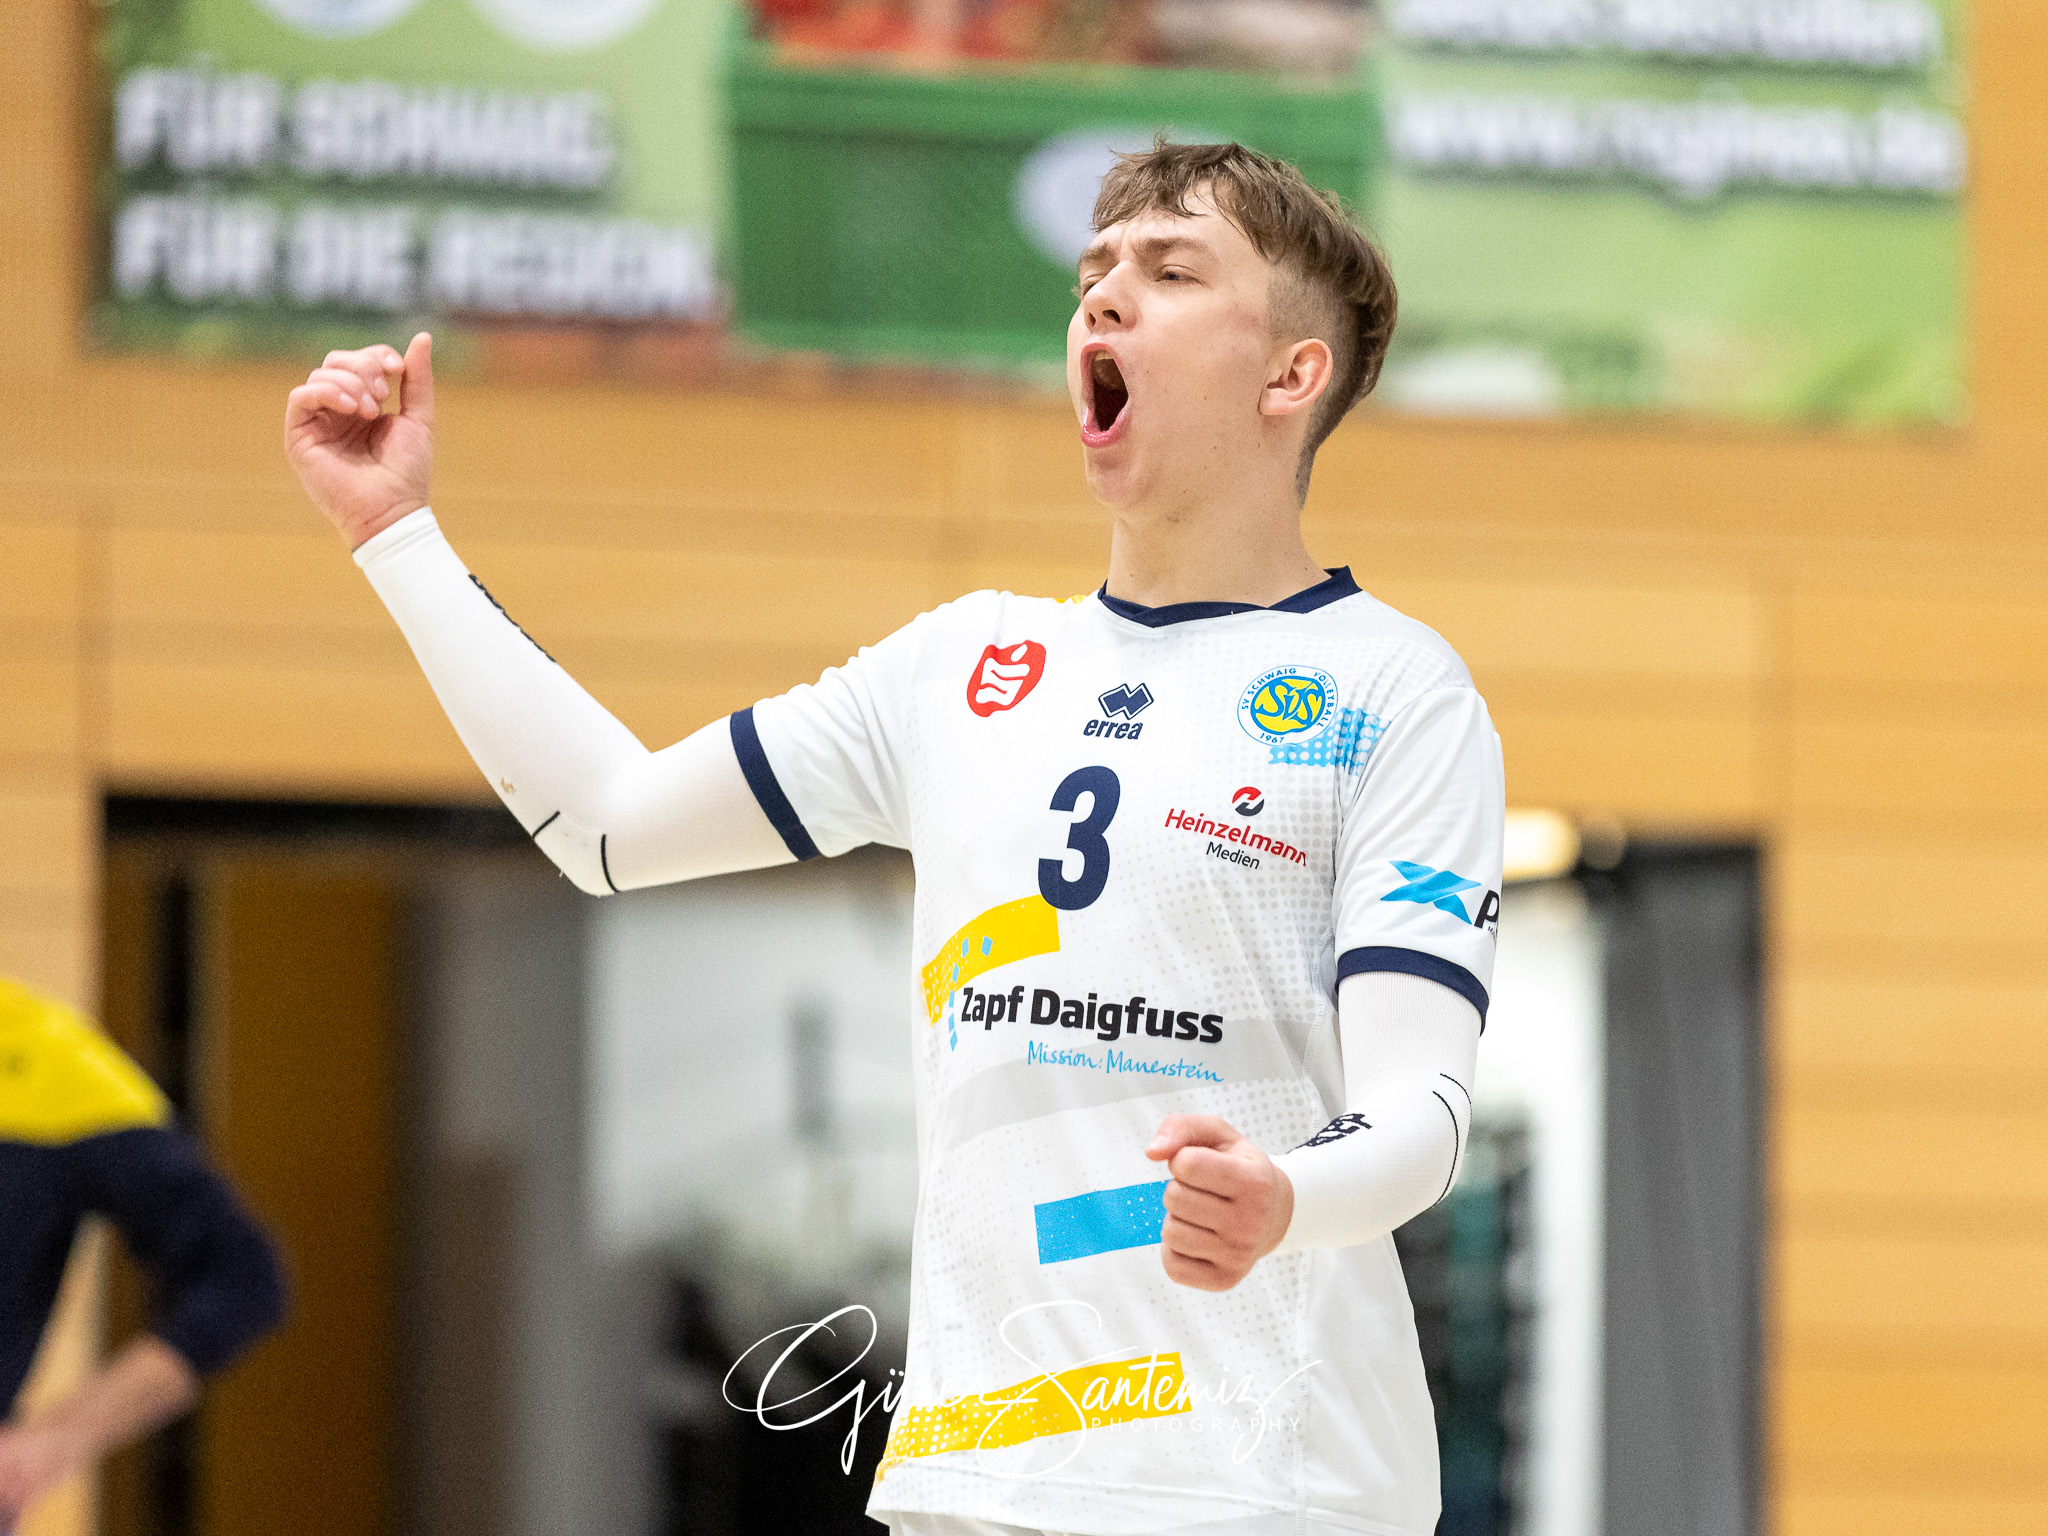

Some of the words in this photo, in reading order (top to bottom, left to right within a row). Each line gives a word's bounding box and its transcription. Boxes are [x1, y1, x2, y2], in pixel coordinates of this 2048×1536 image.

[1241, 697, 1250, 710] SV
[1247, 667, 1297, 696] SCHWAIG
[1313, 671, 1335, 728] VOLLEYBALL
[1259, 732, 1285, 744] 1967
[1038, 766, 1121, 911] 3
[1164, 808, 1308, 867] Heinzelmann
[1205, 841, 1261, 870] Medien
[961, 985, 1025, 1031] Zapf
[1029, 988, 1224, 1044] Daigfuss
[1106, 1048, 1225, 1083] Mauerstein
